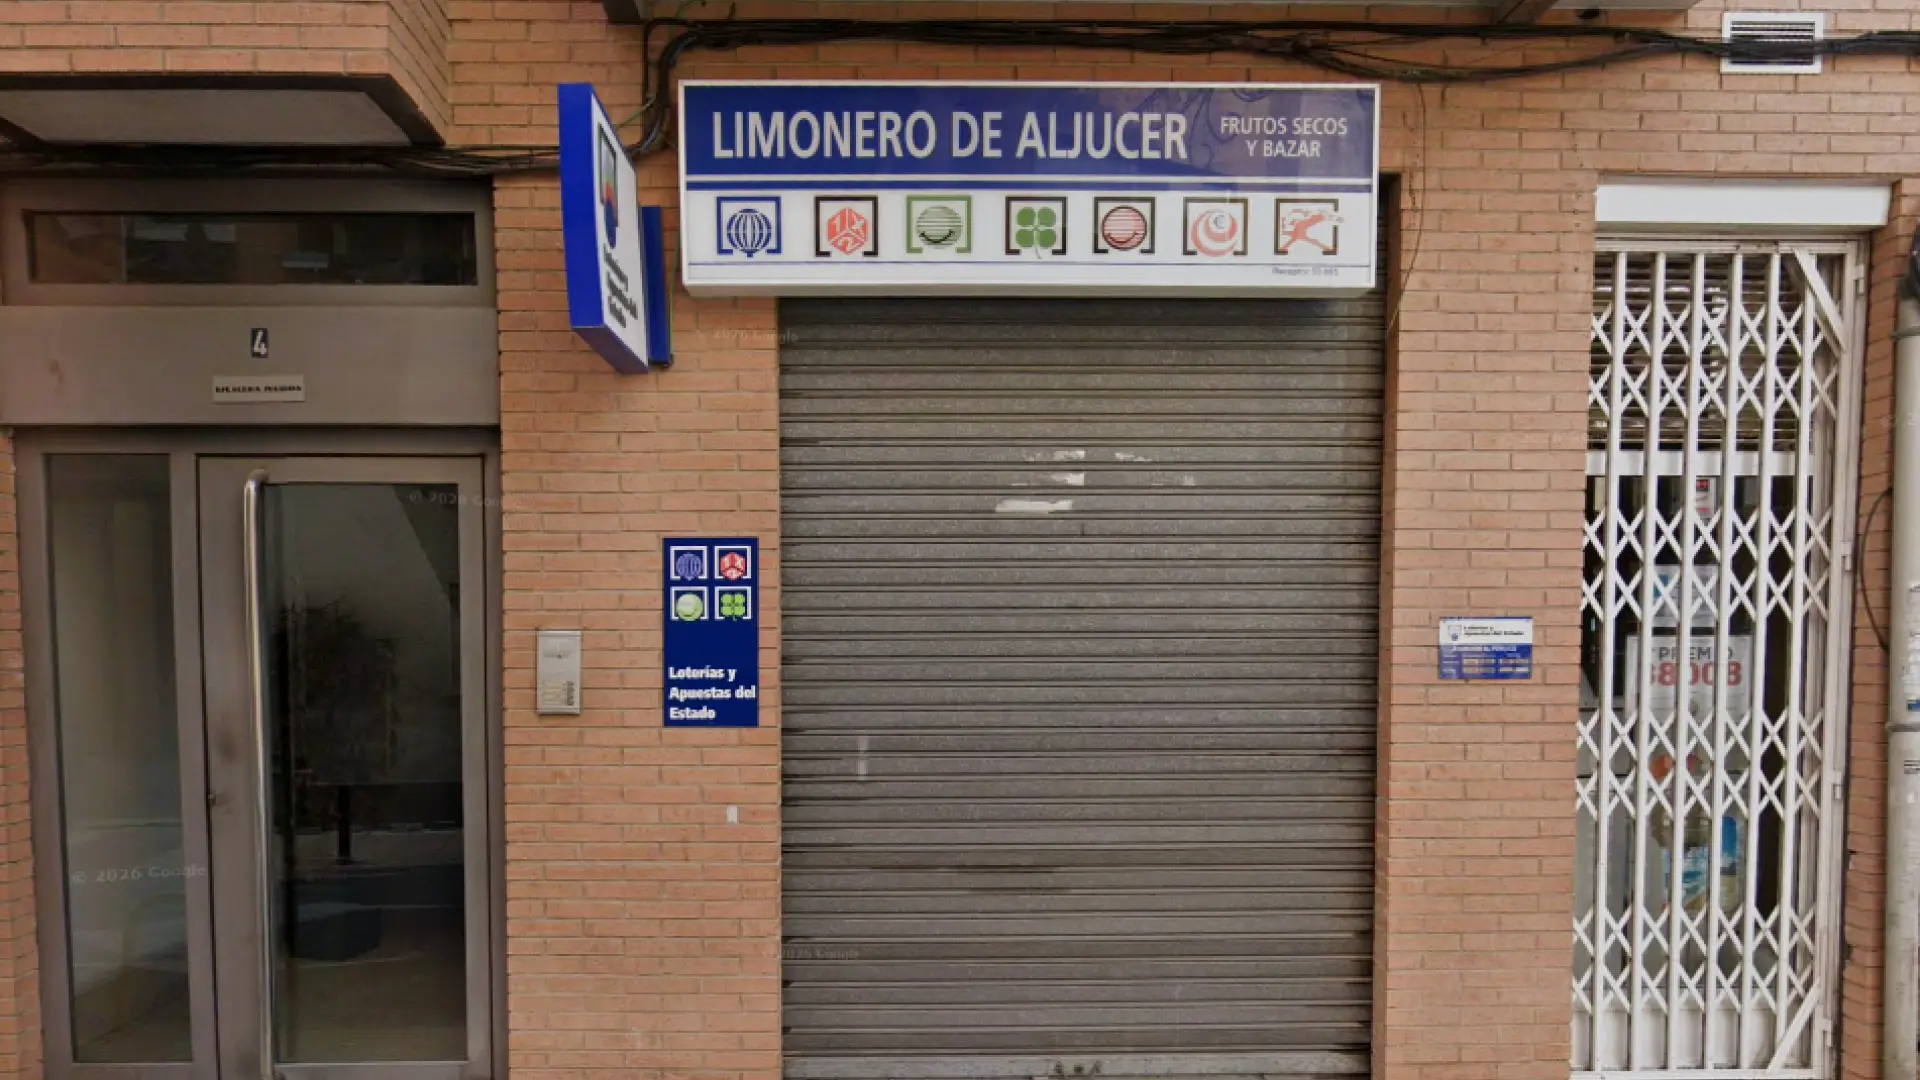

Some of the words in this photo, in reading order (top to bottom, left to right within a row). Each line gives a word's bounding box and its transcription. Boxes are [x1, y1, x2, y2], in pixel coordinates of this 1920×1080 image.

[1220, 115, 1287, 135] FRUTOS
[1292, 117, 1348, 135] SECOS
[712, 110, 937, 158] LIMONERO
[952, 111, 1003, 158] DE
[1015, 111, 1188, 159] ALJUCER
[1245, 139, 1259, 157] Y
[1263, 139, 1321, 157] BAZAR
[253, 329, 267, 355] 4
[1659, 646, 1734, 661] PREM
[669, 664, 725, 679] Loterías
[727, 669, 737, 682] y
[669, 686, 732, 702] Apuestas
[735, 685, 756, 699] del
[669, 705, 716, 720] Estado
